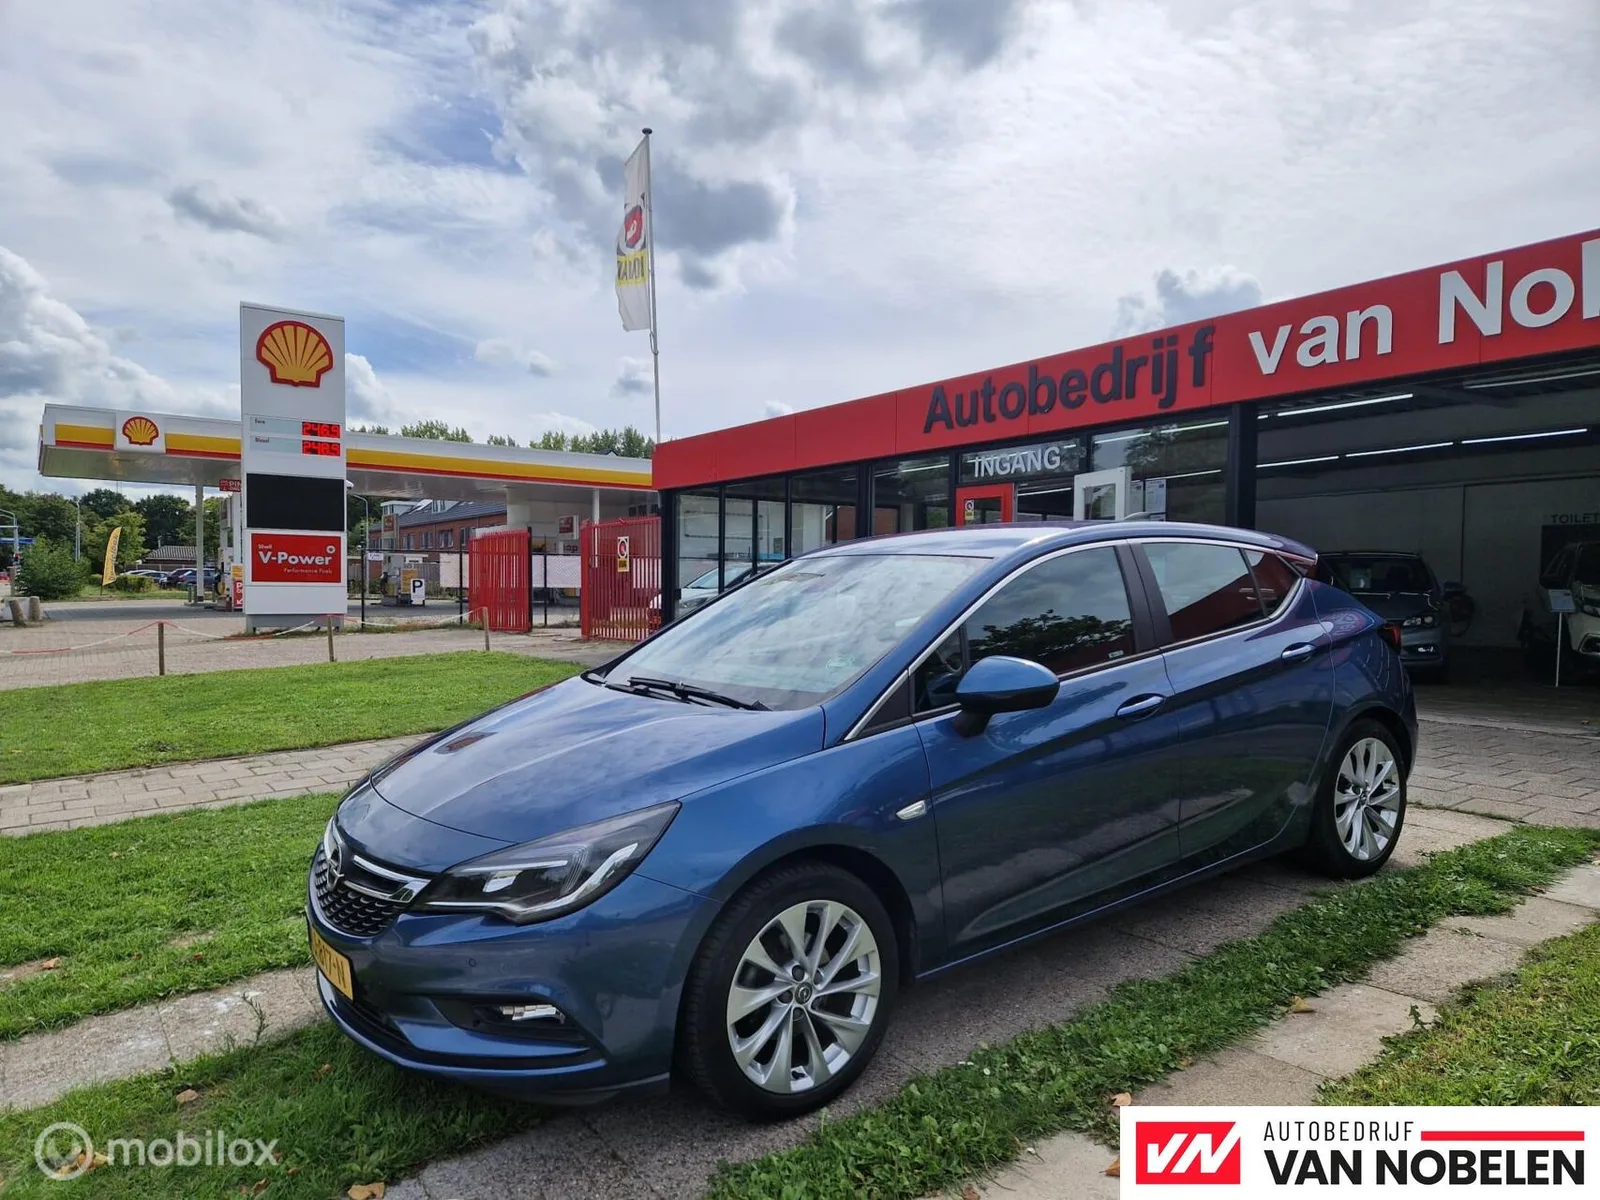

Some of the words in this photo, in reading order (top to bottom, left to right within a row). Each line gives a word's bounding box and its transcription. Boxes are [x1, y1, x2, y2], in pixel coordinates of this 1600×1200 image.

[1247, 304, 1393, 376] van
[974, 446, 1061, 478] INGANG
[258, 551, 332, 565] V-Power
[412, 580, 423, 594] P
